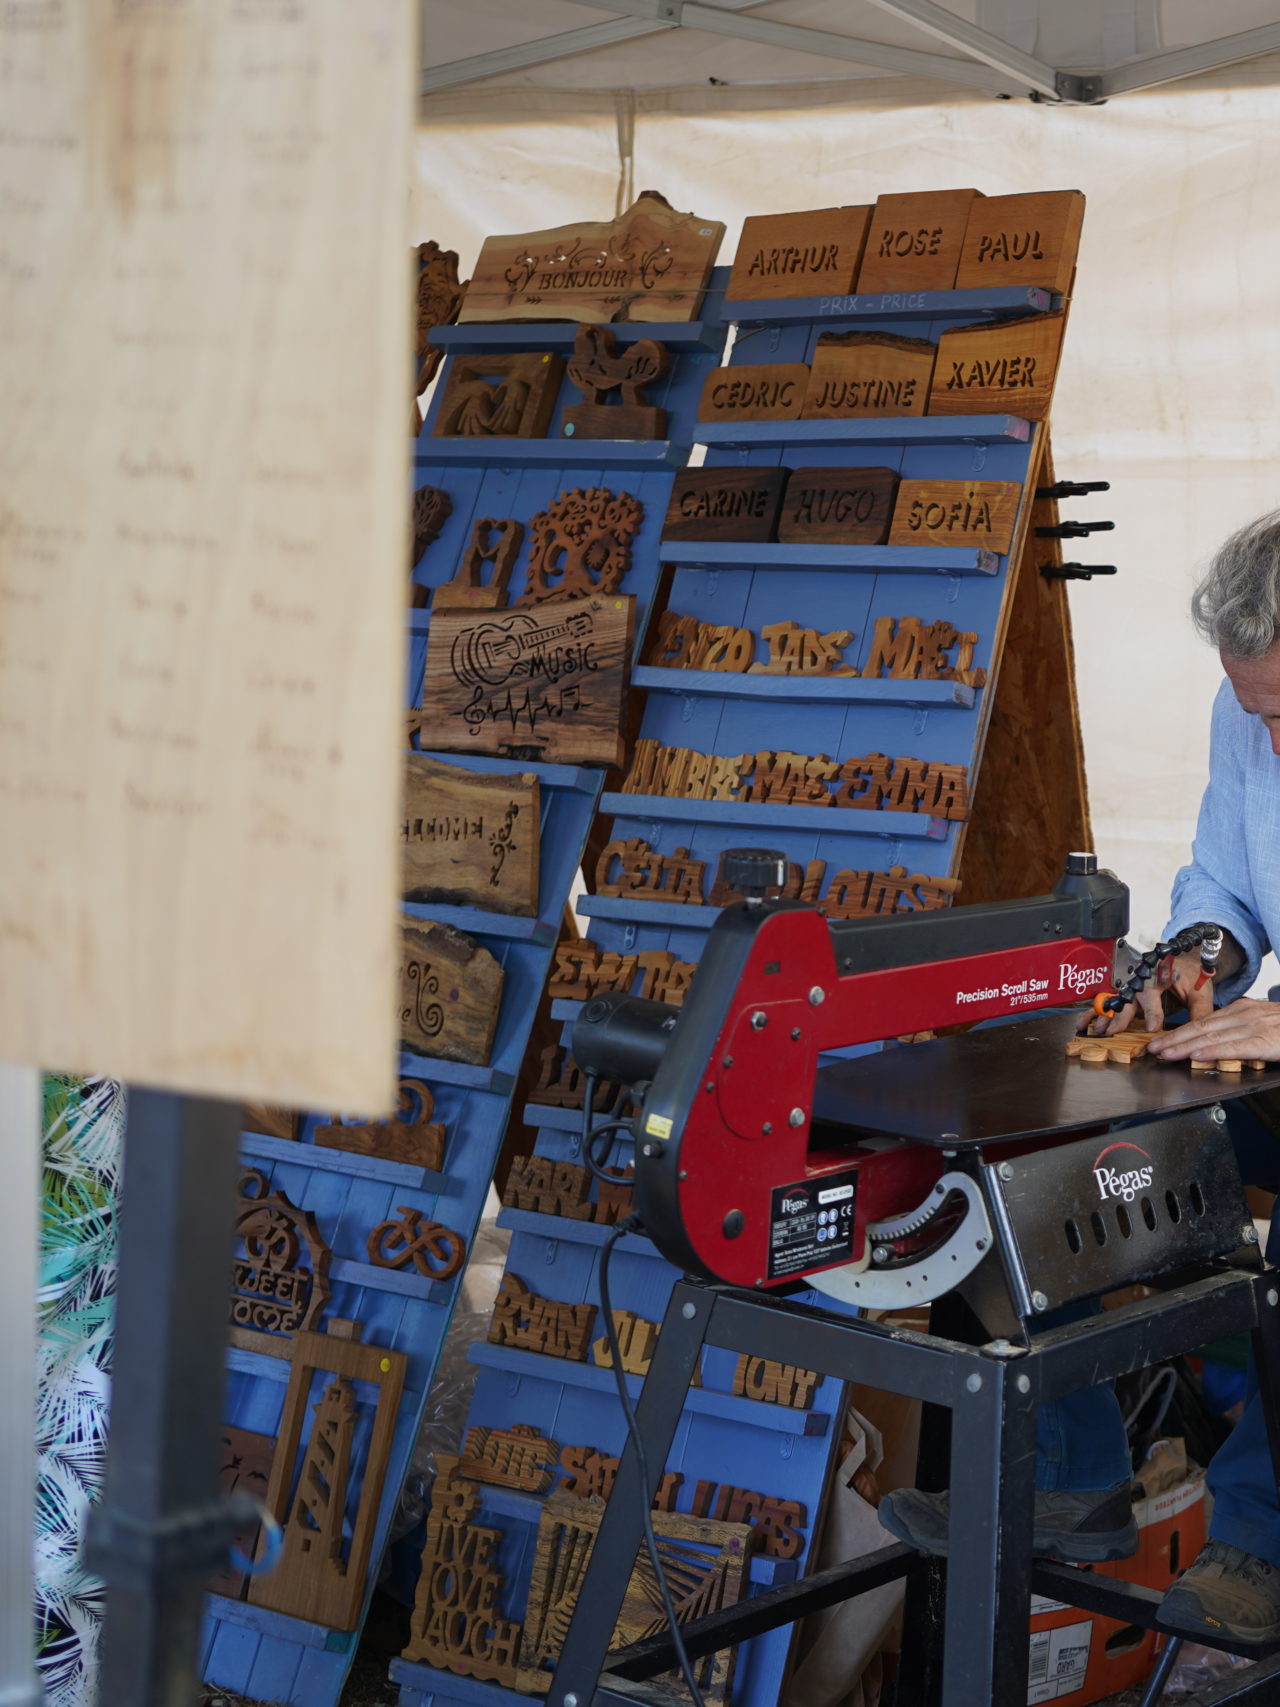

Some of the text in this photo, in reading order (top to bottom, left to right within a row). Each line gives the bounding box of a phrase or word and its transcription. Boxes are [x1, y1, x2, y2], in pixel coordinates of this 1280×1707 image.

[879, 227, 944, 258] ROSE
[977, 230, 1044, 263] PAUL
[748, 243, 839, 277] ARTHUR
[538, 269, 628, 290] BONJOUR
[819, 296, 858, 315] PRIX
[880, 293, 925, 311] PRICE
[946, 356, 1037, 390] XAVIER
[815, 378, 917, 409] JUSTINE
[680, 488, 769, 518] CARINE
[793, 488, 875, 524] HUGO
[650, 610, 756, 674] ENZO
[747, 620, 857, 677] JADE
[835, 752, 969, 822] EMMA
[956, 978, 1050, 1005] Precision Scroll Saw
[1057, 963, 1104, 995] Pégas
[1093, 1166, 1152, 1202] Pégas
[234, 1265, 311, 1308] WEET
[233, 1299, 304, 1334] OME
